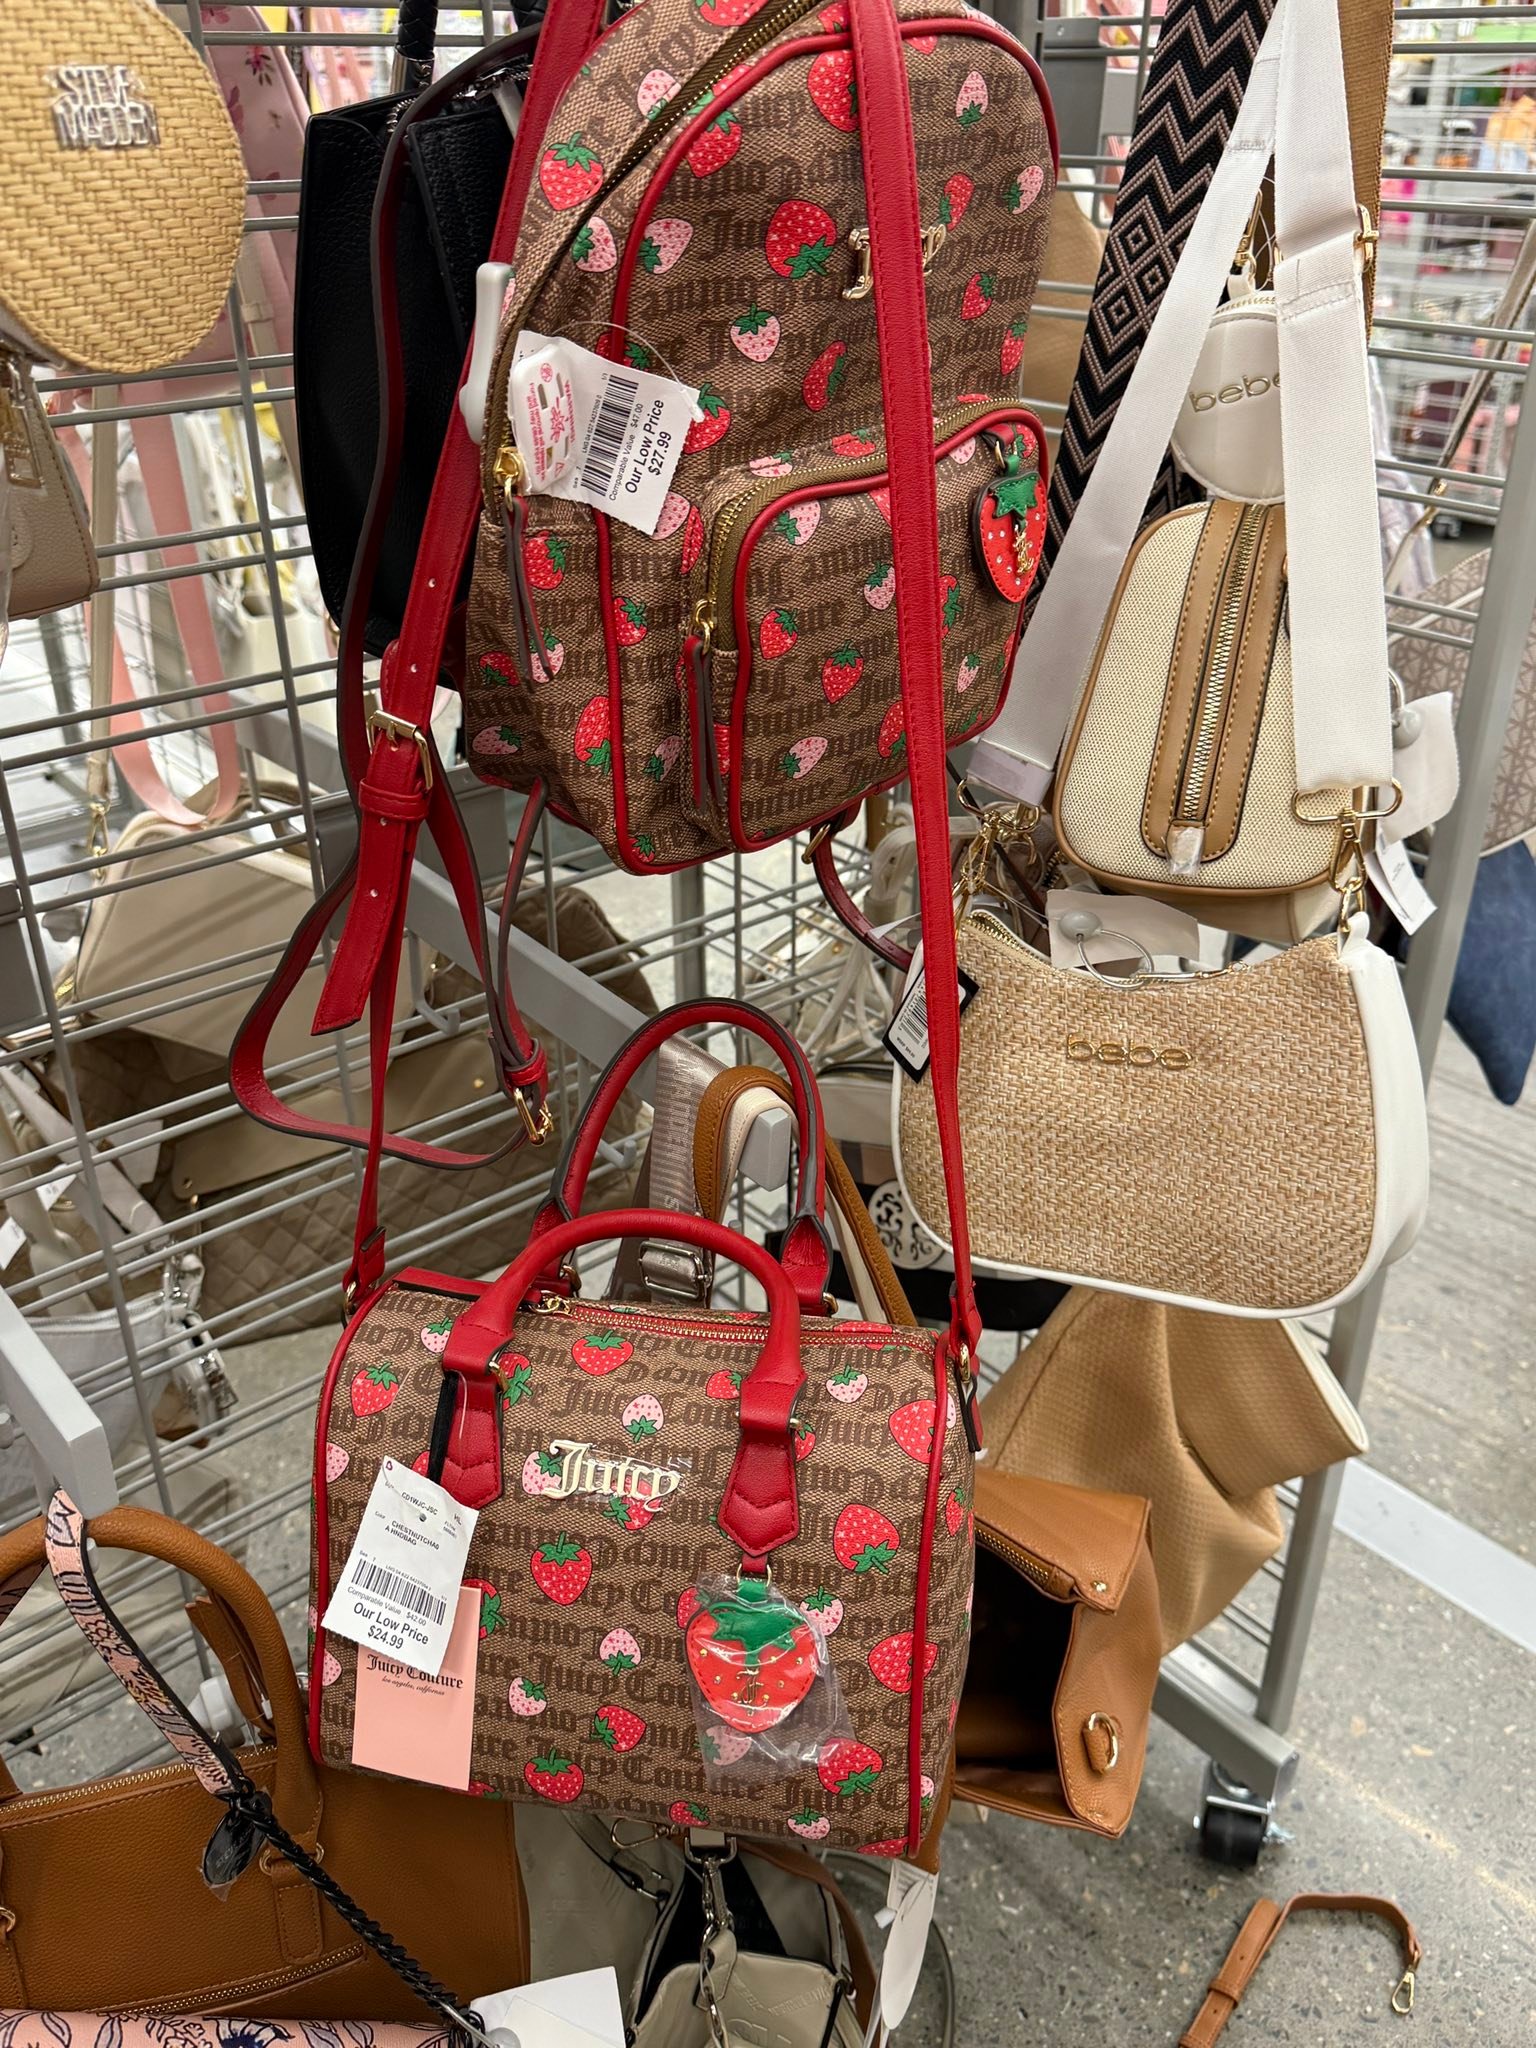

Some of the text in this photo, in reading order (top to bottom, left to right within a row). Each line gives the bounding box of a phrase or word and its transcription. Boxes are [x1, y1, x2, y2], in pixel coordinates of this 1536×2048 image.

[55, 64, 130, 107] STEVE
[52, 102, 161, 149] MADDEN
[608, 403, 644, 501] Comparable Value $47.00
[625, 399, 664, 494] Our Low Price
[648, 431, 672, 476] $27.99
[1066, 1033, 1193, 1070] bebe
[541, 1439, 681, 1512] Juicy
[347, 1586, 427, 1627] Comparable Value $42.00
[353, 1602, 429, 1645] Our Low Price
[367, 1625, 404, 1650] $24.99
[366, 1653, 464, 1689] Juicy Couture
